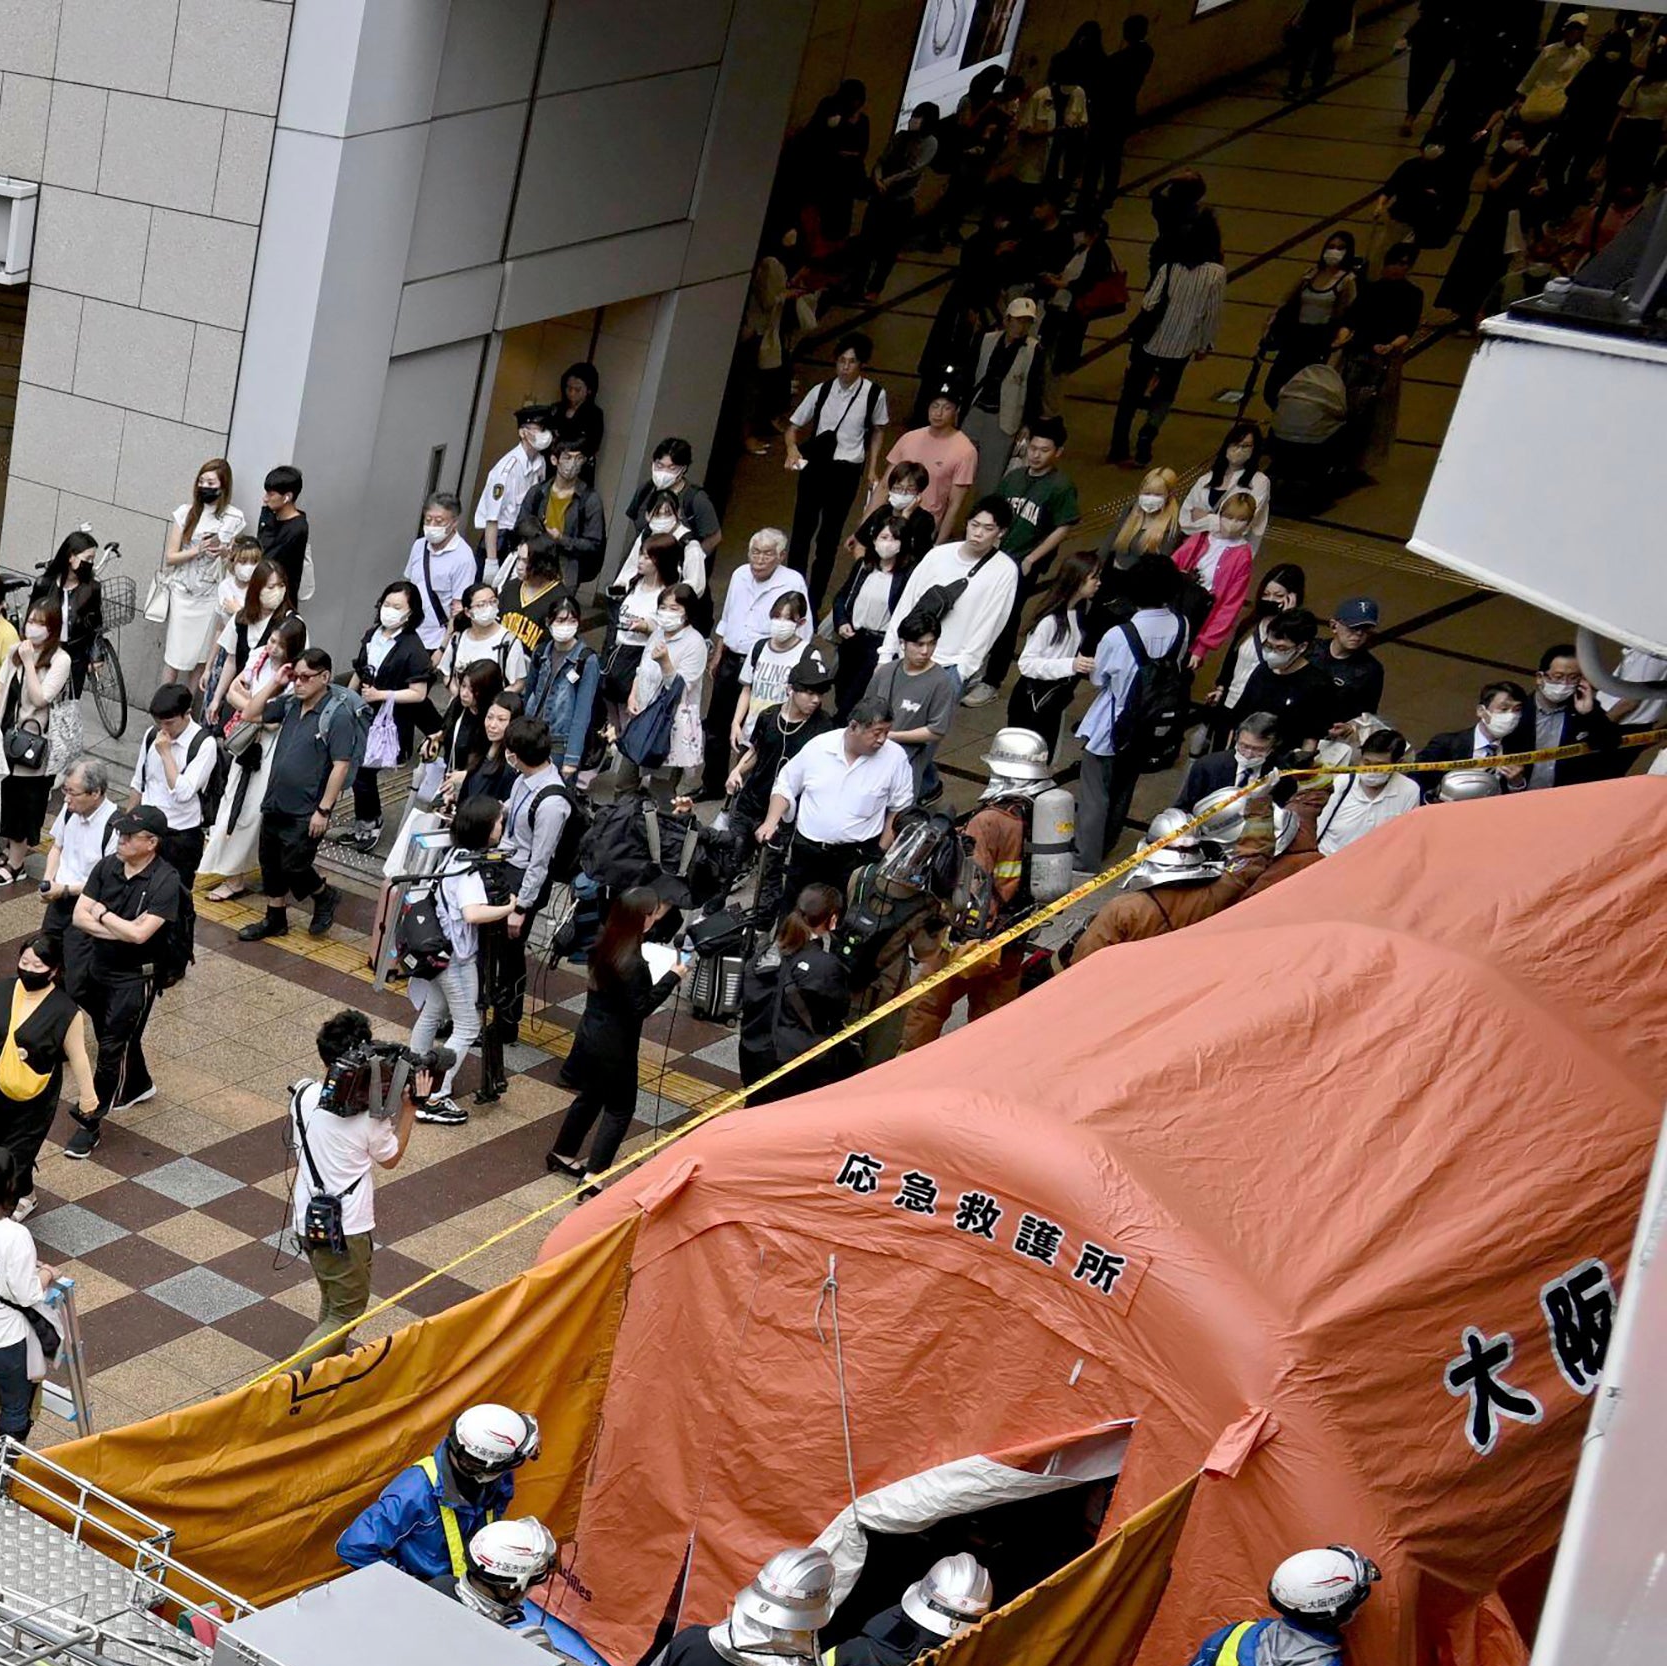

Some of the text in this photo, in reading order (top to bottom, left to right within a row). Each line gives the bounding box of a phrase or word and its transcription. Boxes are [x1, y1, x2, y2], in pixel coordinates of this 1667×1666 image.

[835, 1150, 1128, 1295] 応急救護所
[491, 1560, 533, 1574] 大阪市消
[1307, 1586, 1361, 1610] 大阪市消防
